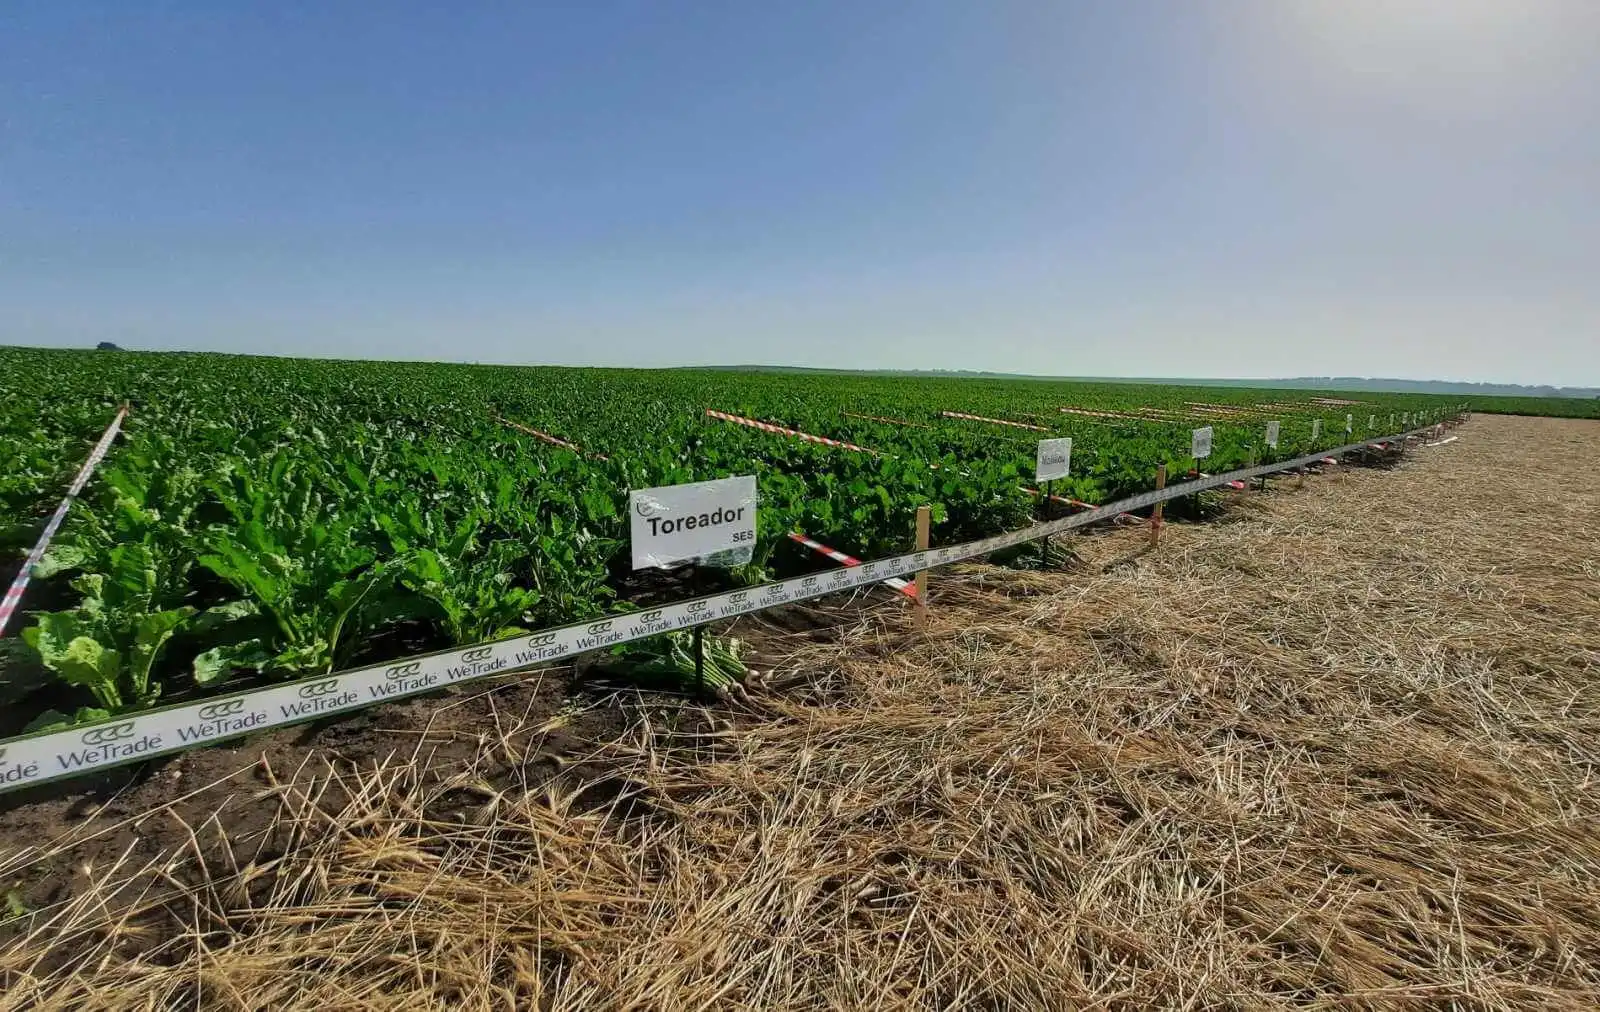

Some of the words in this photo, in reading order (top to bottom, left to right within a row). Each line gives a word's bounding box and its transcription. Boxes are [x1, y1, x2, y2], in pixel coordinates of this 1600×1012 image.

[647, 507, 745, 537] Toreador
[732, 530, 754, 543] SES
[56, 732, 163, 770] WeTrade
[177, 711, 267, 743] WeTrade
[280, 689, 358, 718] WeTrade
[369, 672, 437, 698] WeTrade
[447, 655, 506, 681] WeTrade
[515, 642, 569, 665] WeTrade
[576, 629, 624, 650] WeTrade
[629, 618, 672, 637] WeTrade
[677, 608, 715, 627] WeTrade
[720, 599, 755, 617] WeTrade
[759, 591, 790, 608] WeTrade
[794, 583, 823, 599] WeTrade
